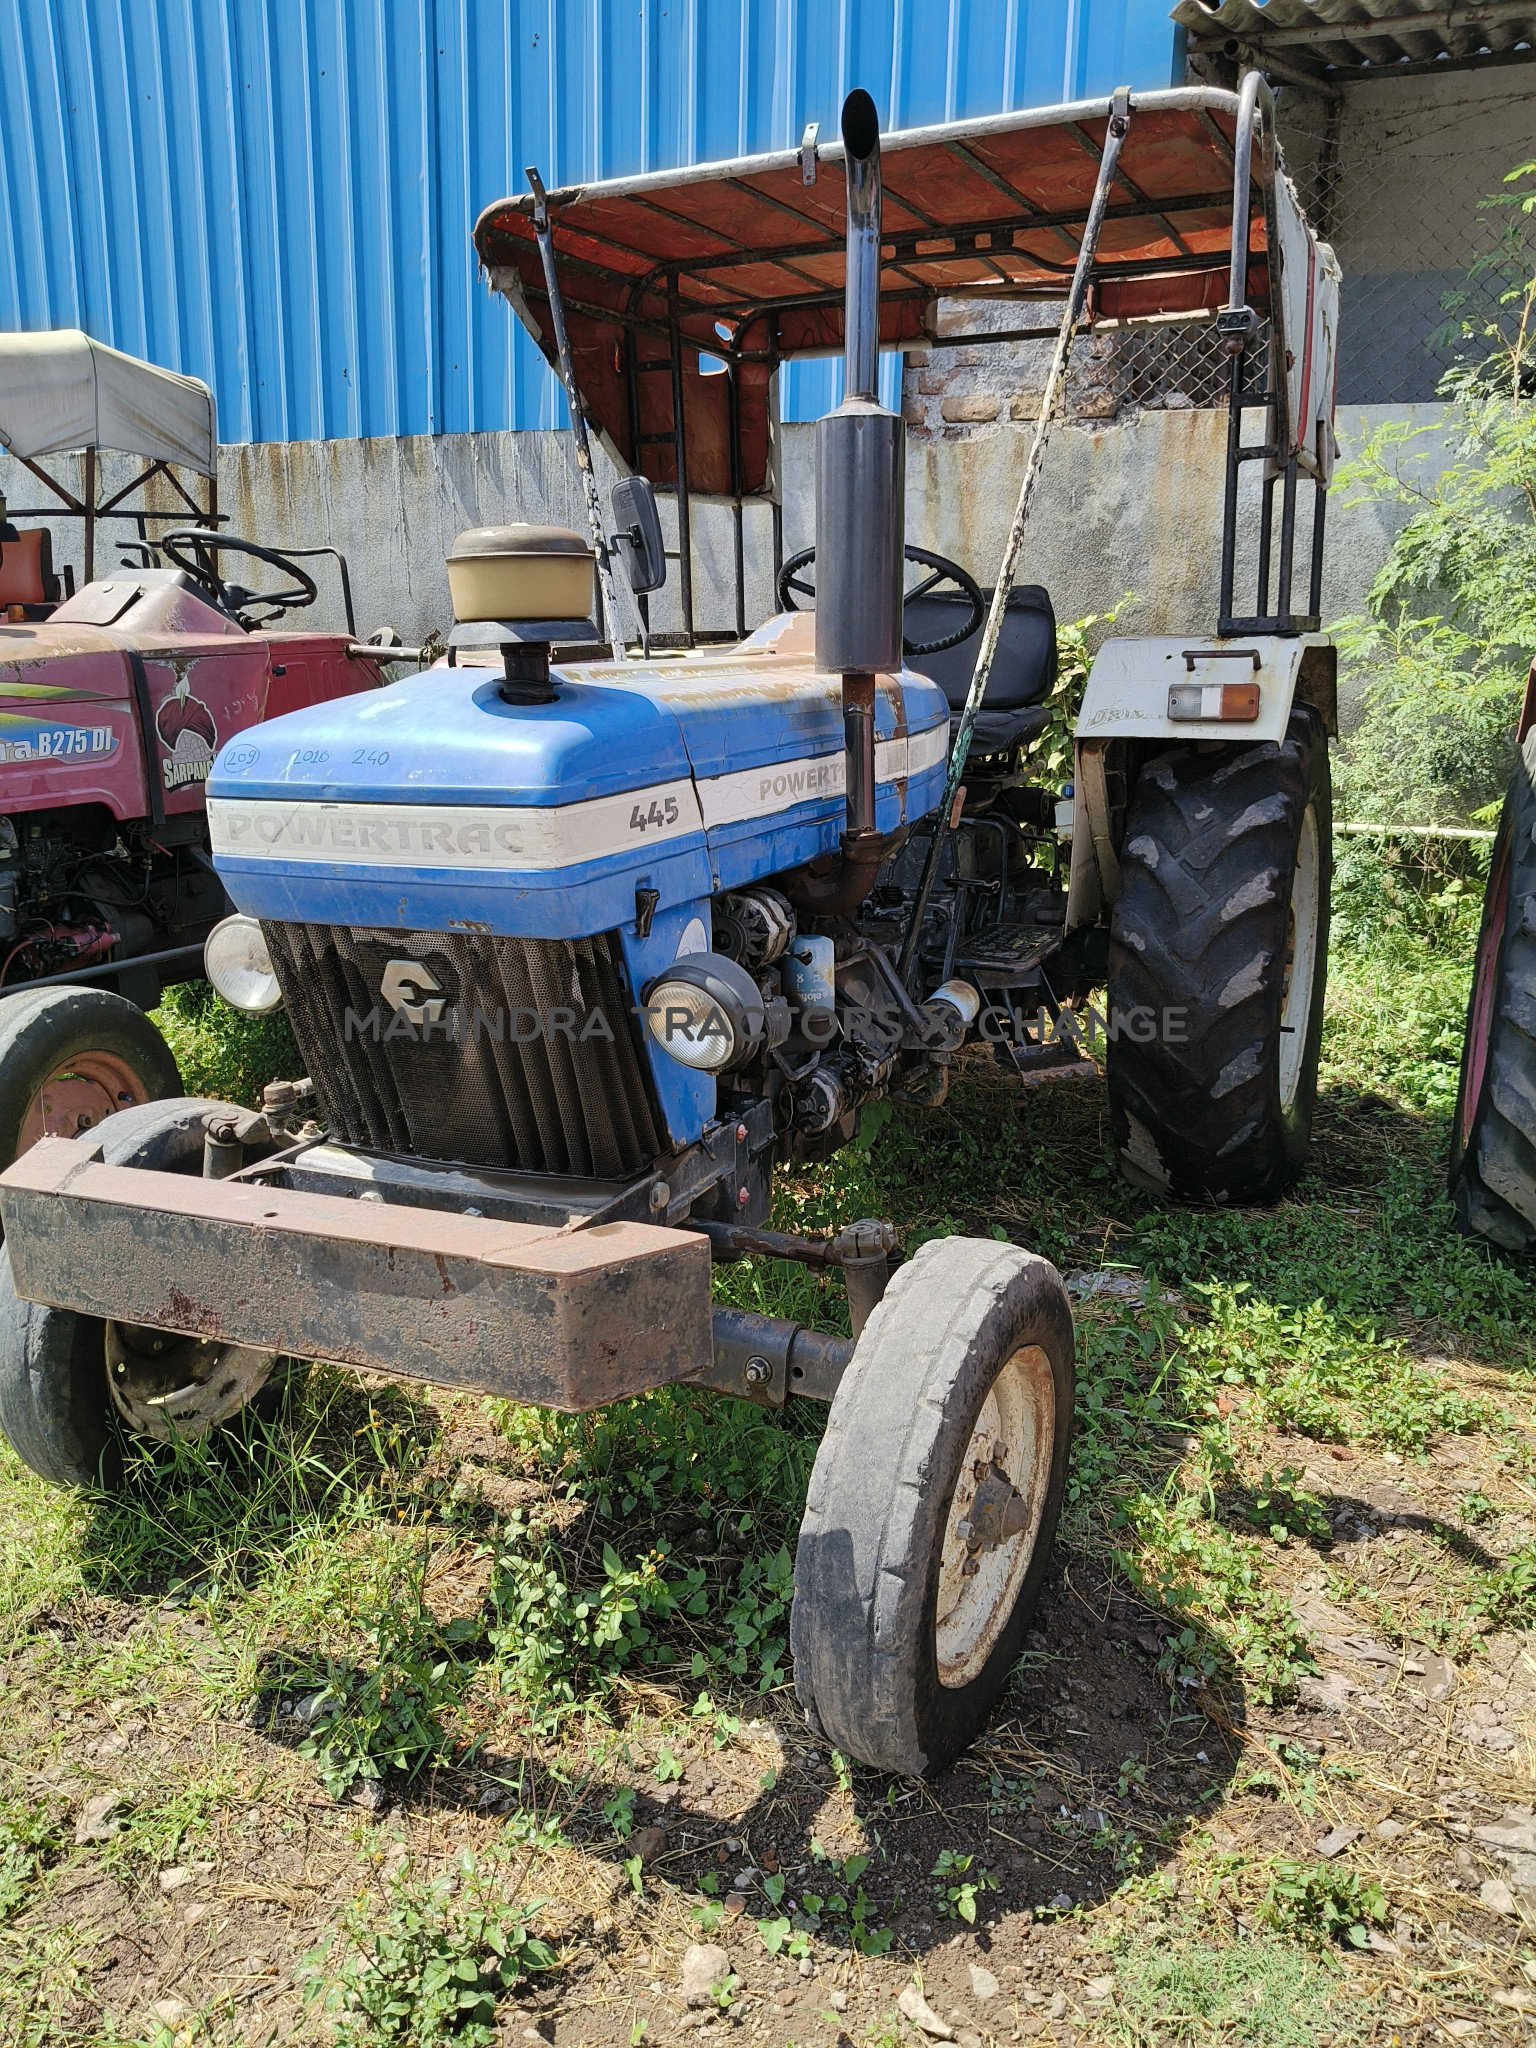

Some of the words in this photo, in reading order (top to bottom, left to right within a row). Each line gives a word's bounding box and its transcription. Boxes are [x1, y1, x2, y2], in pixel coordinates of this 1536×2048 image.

[38, 730, 87, 757] B275
[92, 726, 112, 752] DI
[227, 749, 257, 766] 209
[162, 754, 217, 789] SARPANC
[629, 796, 679, 832] 445
[227, 813, 526, 854] POWERTRAC
